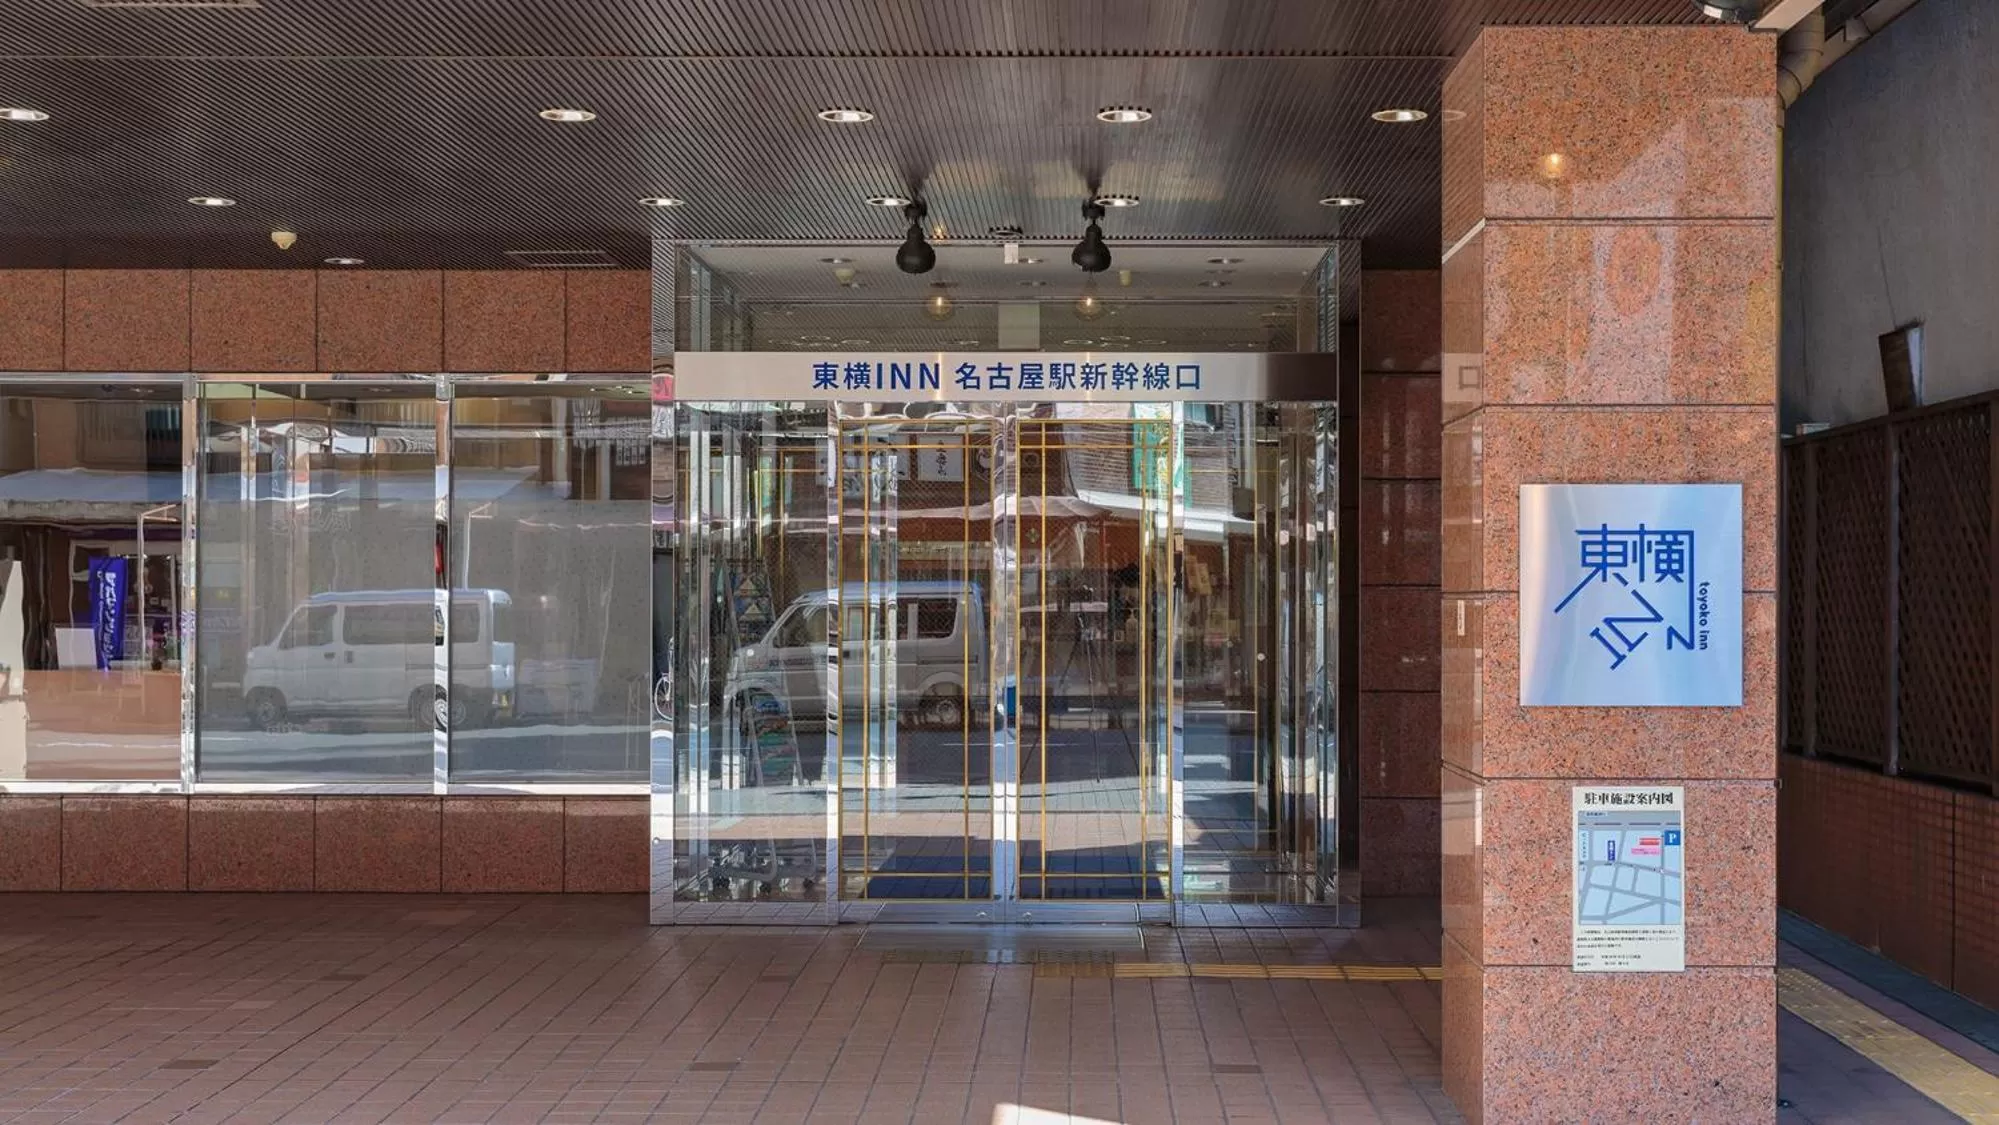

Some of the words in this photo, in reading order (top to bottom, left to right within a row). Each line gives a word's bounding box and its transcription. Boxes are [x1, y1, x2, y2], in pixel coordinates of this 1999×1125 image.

[812, 363, 941, 390] 東横INN
[955, 363, 1202, 390] 名古屋駅新幹線口
[1697, 581, 1712, 627] toyoko
[1698, 630, 1709, 651] inn
[1584, 791, 1674, 805] 駐車施設案内図
